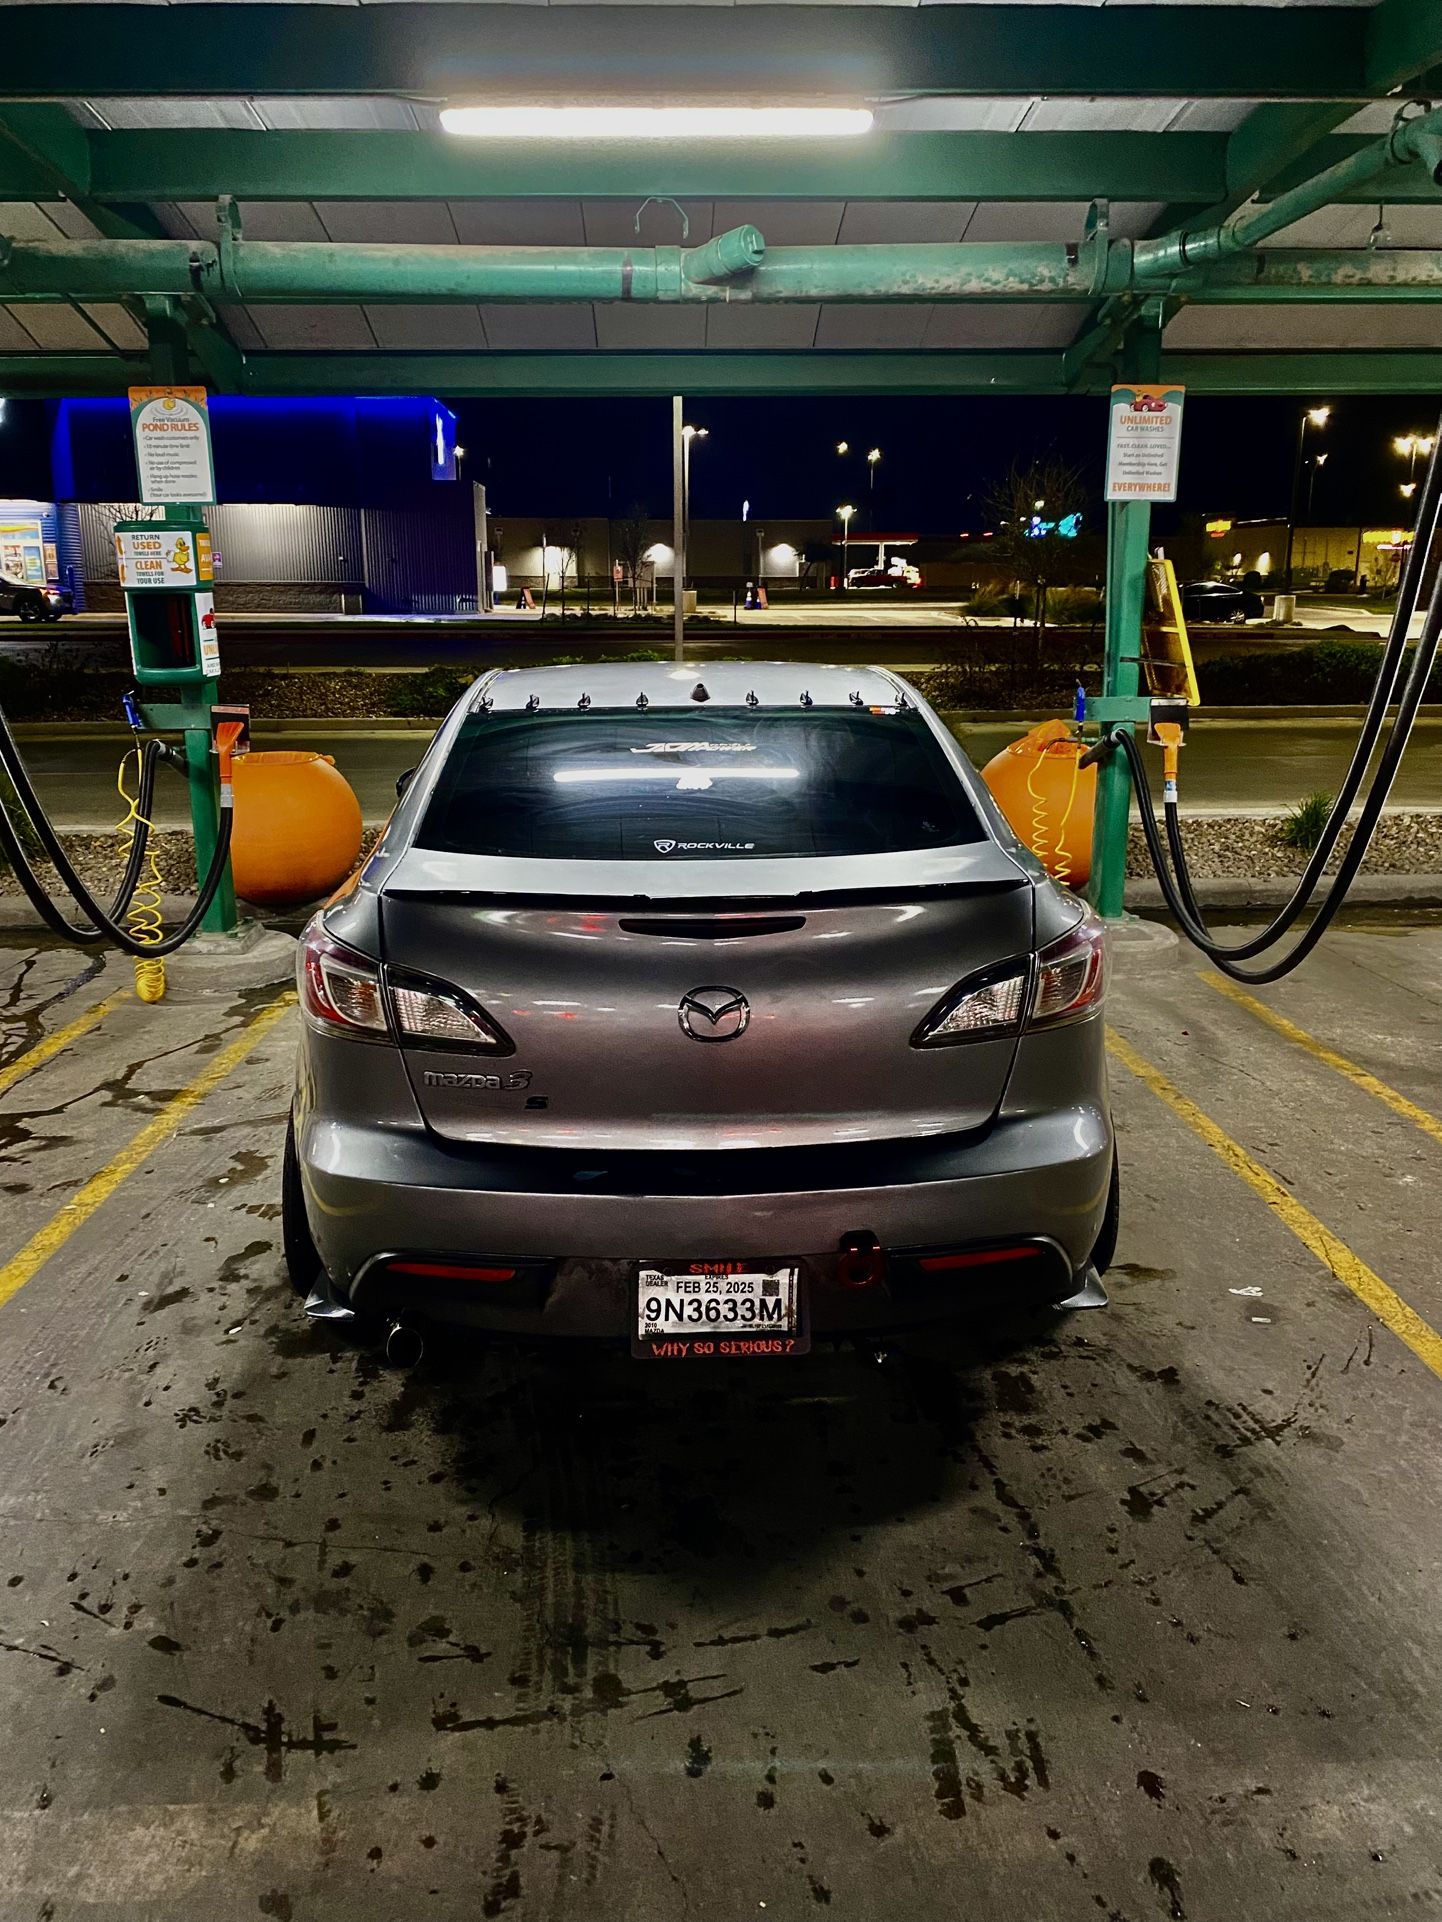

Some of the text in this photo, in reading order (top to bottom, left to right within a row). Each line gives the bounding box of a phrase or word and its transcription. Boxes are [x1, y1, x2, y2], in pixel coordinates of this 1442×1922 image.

[1120, 415, 1173, 425] UNLIMITED
[142, 423, 200, 432] POND RULES
[1112, 482, 1171, 492] EVERYWHERE!
[132, 541, 162, 550] USED
[135, 560, 162, 570] CLEAN
[677, 842, 755, 850] ROCKVILLE
[502, 1068, 533, 1090] 3
[676, 1281, 754, 1295] FEB 25, 2025
[645, 1297, 783, 1322] 9N3633M
[651, 1342, 690, 1358] WHY
[693, 1342, 715, 1354] SO
